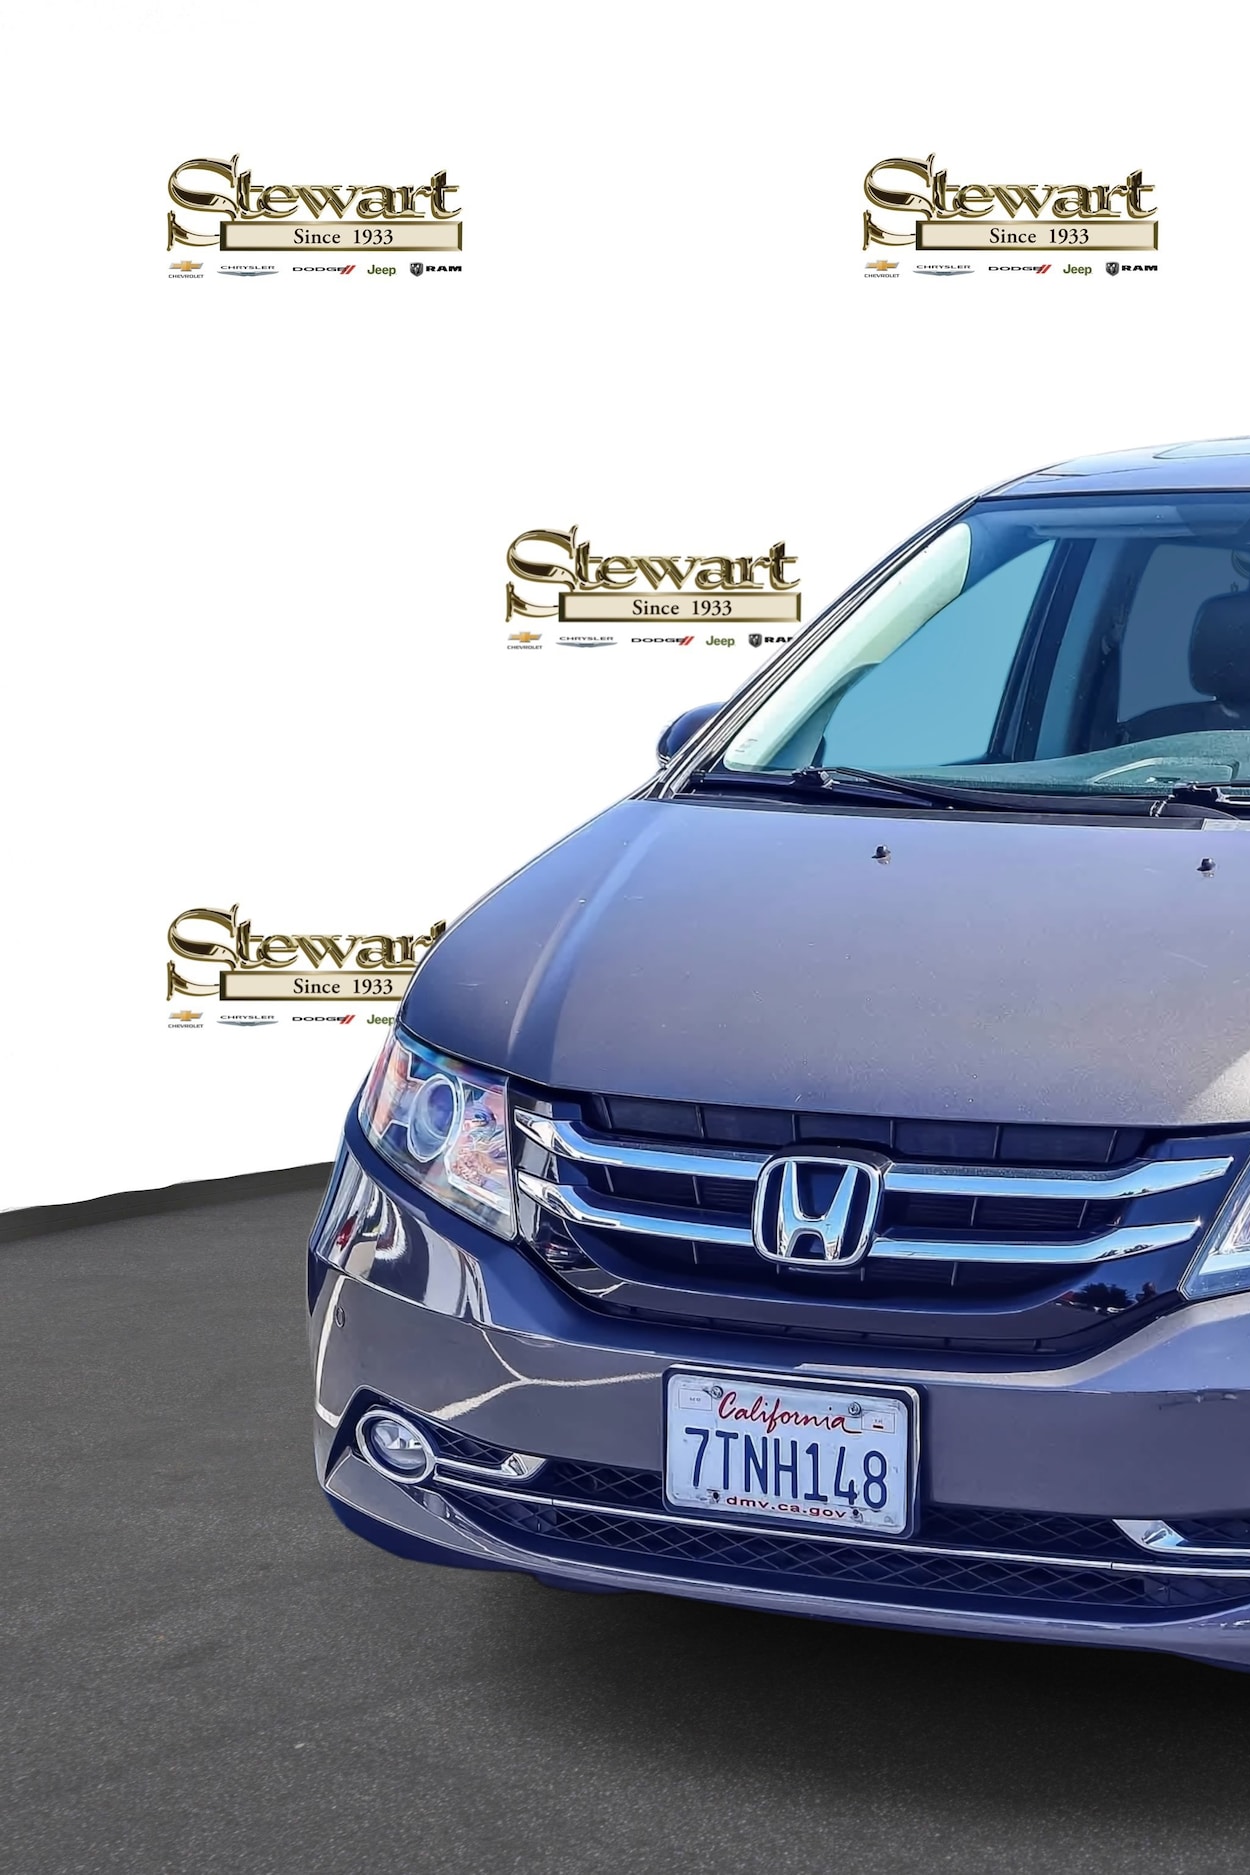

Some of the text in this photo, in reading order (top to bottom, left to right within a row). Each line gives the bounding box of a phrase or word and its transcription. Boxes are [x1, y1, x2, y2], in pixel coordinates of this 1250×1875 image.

[718, 1391, 862, 1434] California
[685, 1427, 887, 1512] 7TNH148
[726, 1496, 847, 1519] dmv.ca.gov
